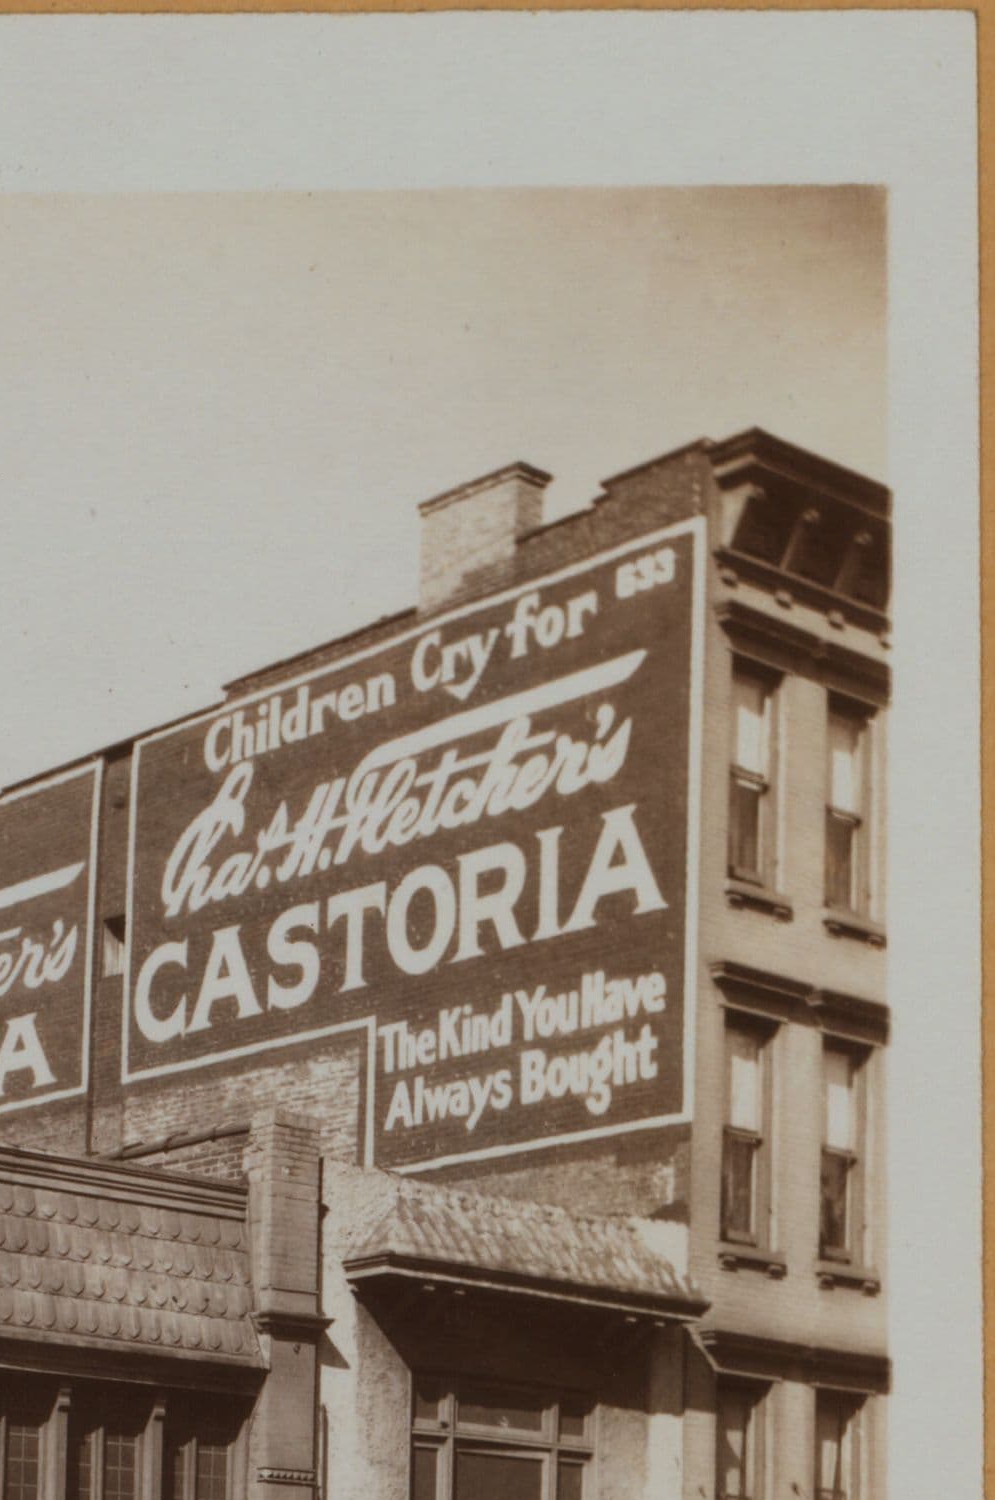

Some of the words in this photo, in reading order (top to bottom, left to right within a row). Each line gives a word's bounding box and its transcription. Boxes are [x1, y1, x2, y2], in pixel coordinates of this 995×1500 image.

[205, 673, 396, 773] Children
[411, 626, 500, 701] Cry
[507, 591, 598, 660] for
[134, 804, 669, 1043] CASTORIA
[378, 1020, 437, 1074] The
[439, 993, 513, 1061] Kind
[515, 985, 579, 1042] You
[581, 970, 667, 1029] Have
[384, 1068, 513, 1132] Always
[520, 1023, 659, 1115] Bought
